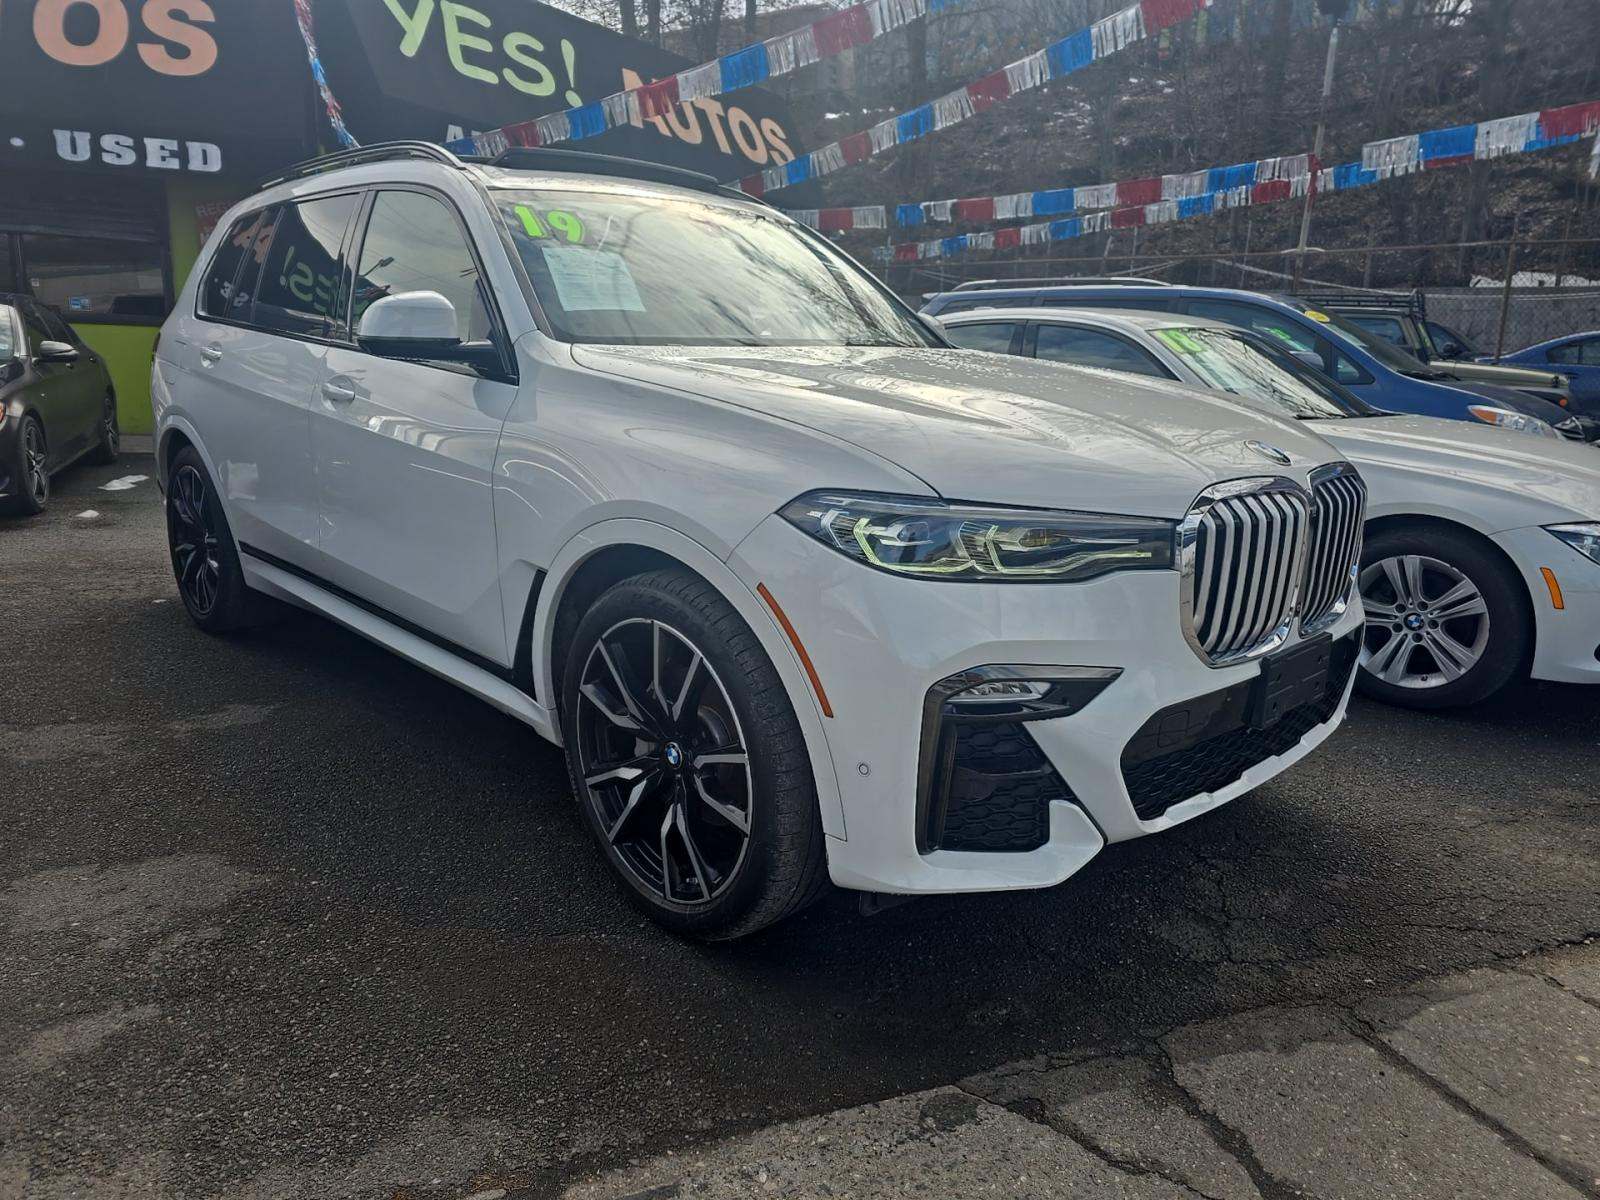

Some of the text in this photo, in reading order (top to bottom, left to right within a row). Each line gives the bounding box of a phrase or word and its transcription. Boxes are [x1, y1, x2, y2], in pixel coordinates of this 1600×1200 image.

[380, 0, 583, 108] YES!
[53, 130, 222, 172] USED
[621, 68, 795, 166] AUTOS
[514, 206, 582, 243] 19
